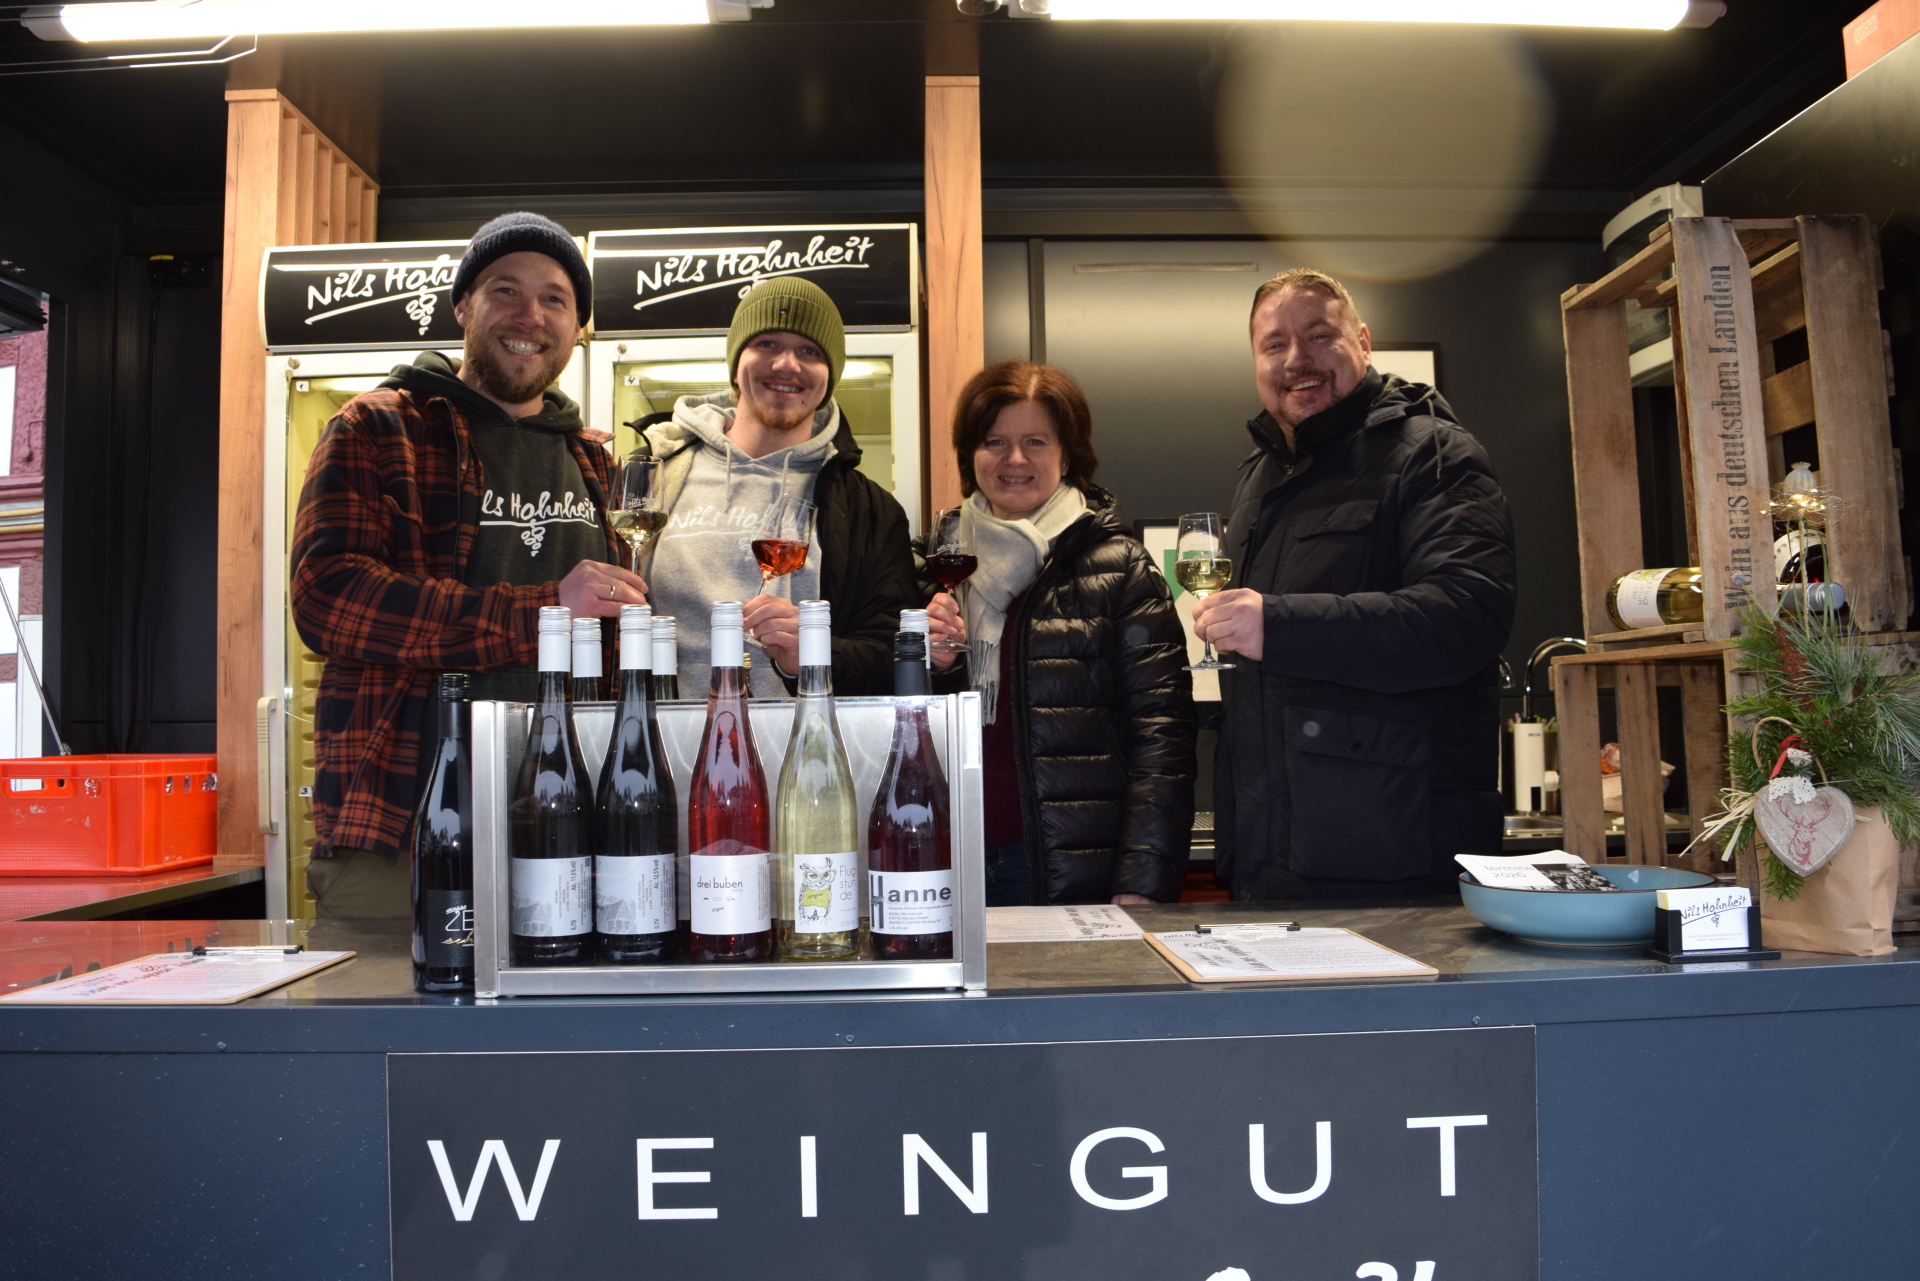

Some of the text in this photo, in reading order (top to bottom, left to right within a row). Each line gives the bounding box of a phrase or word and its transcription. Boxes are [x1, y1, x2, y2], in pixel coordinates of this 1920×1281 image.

[636, 235, 875, 295] Nils Hohnheit
[307, 268, 377, 310] Nils
[1703, 265, 1738, 354] Landen
[627, 376, 636, 385] 4
[1712, 360, 1749, 487] deutschen
[510, 491, 597, 522] Hohnheit
[669, 505, 720, 530] Nils
[300, 787, 308, 795] 3
[696, 876, 743, 889] drei buben
[839, 865, 856, 878] Flug
[839, 879, 856, 889] stun
[840, 889, 852, 901] de
[870, 874, 952, 929] Hanne
[1681, 895, 1747, 920] Nils Hohnheit
[427, 1114, 1487, 1222] WEINGUT
